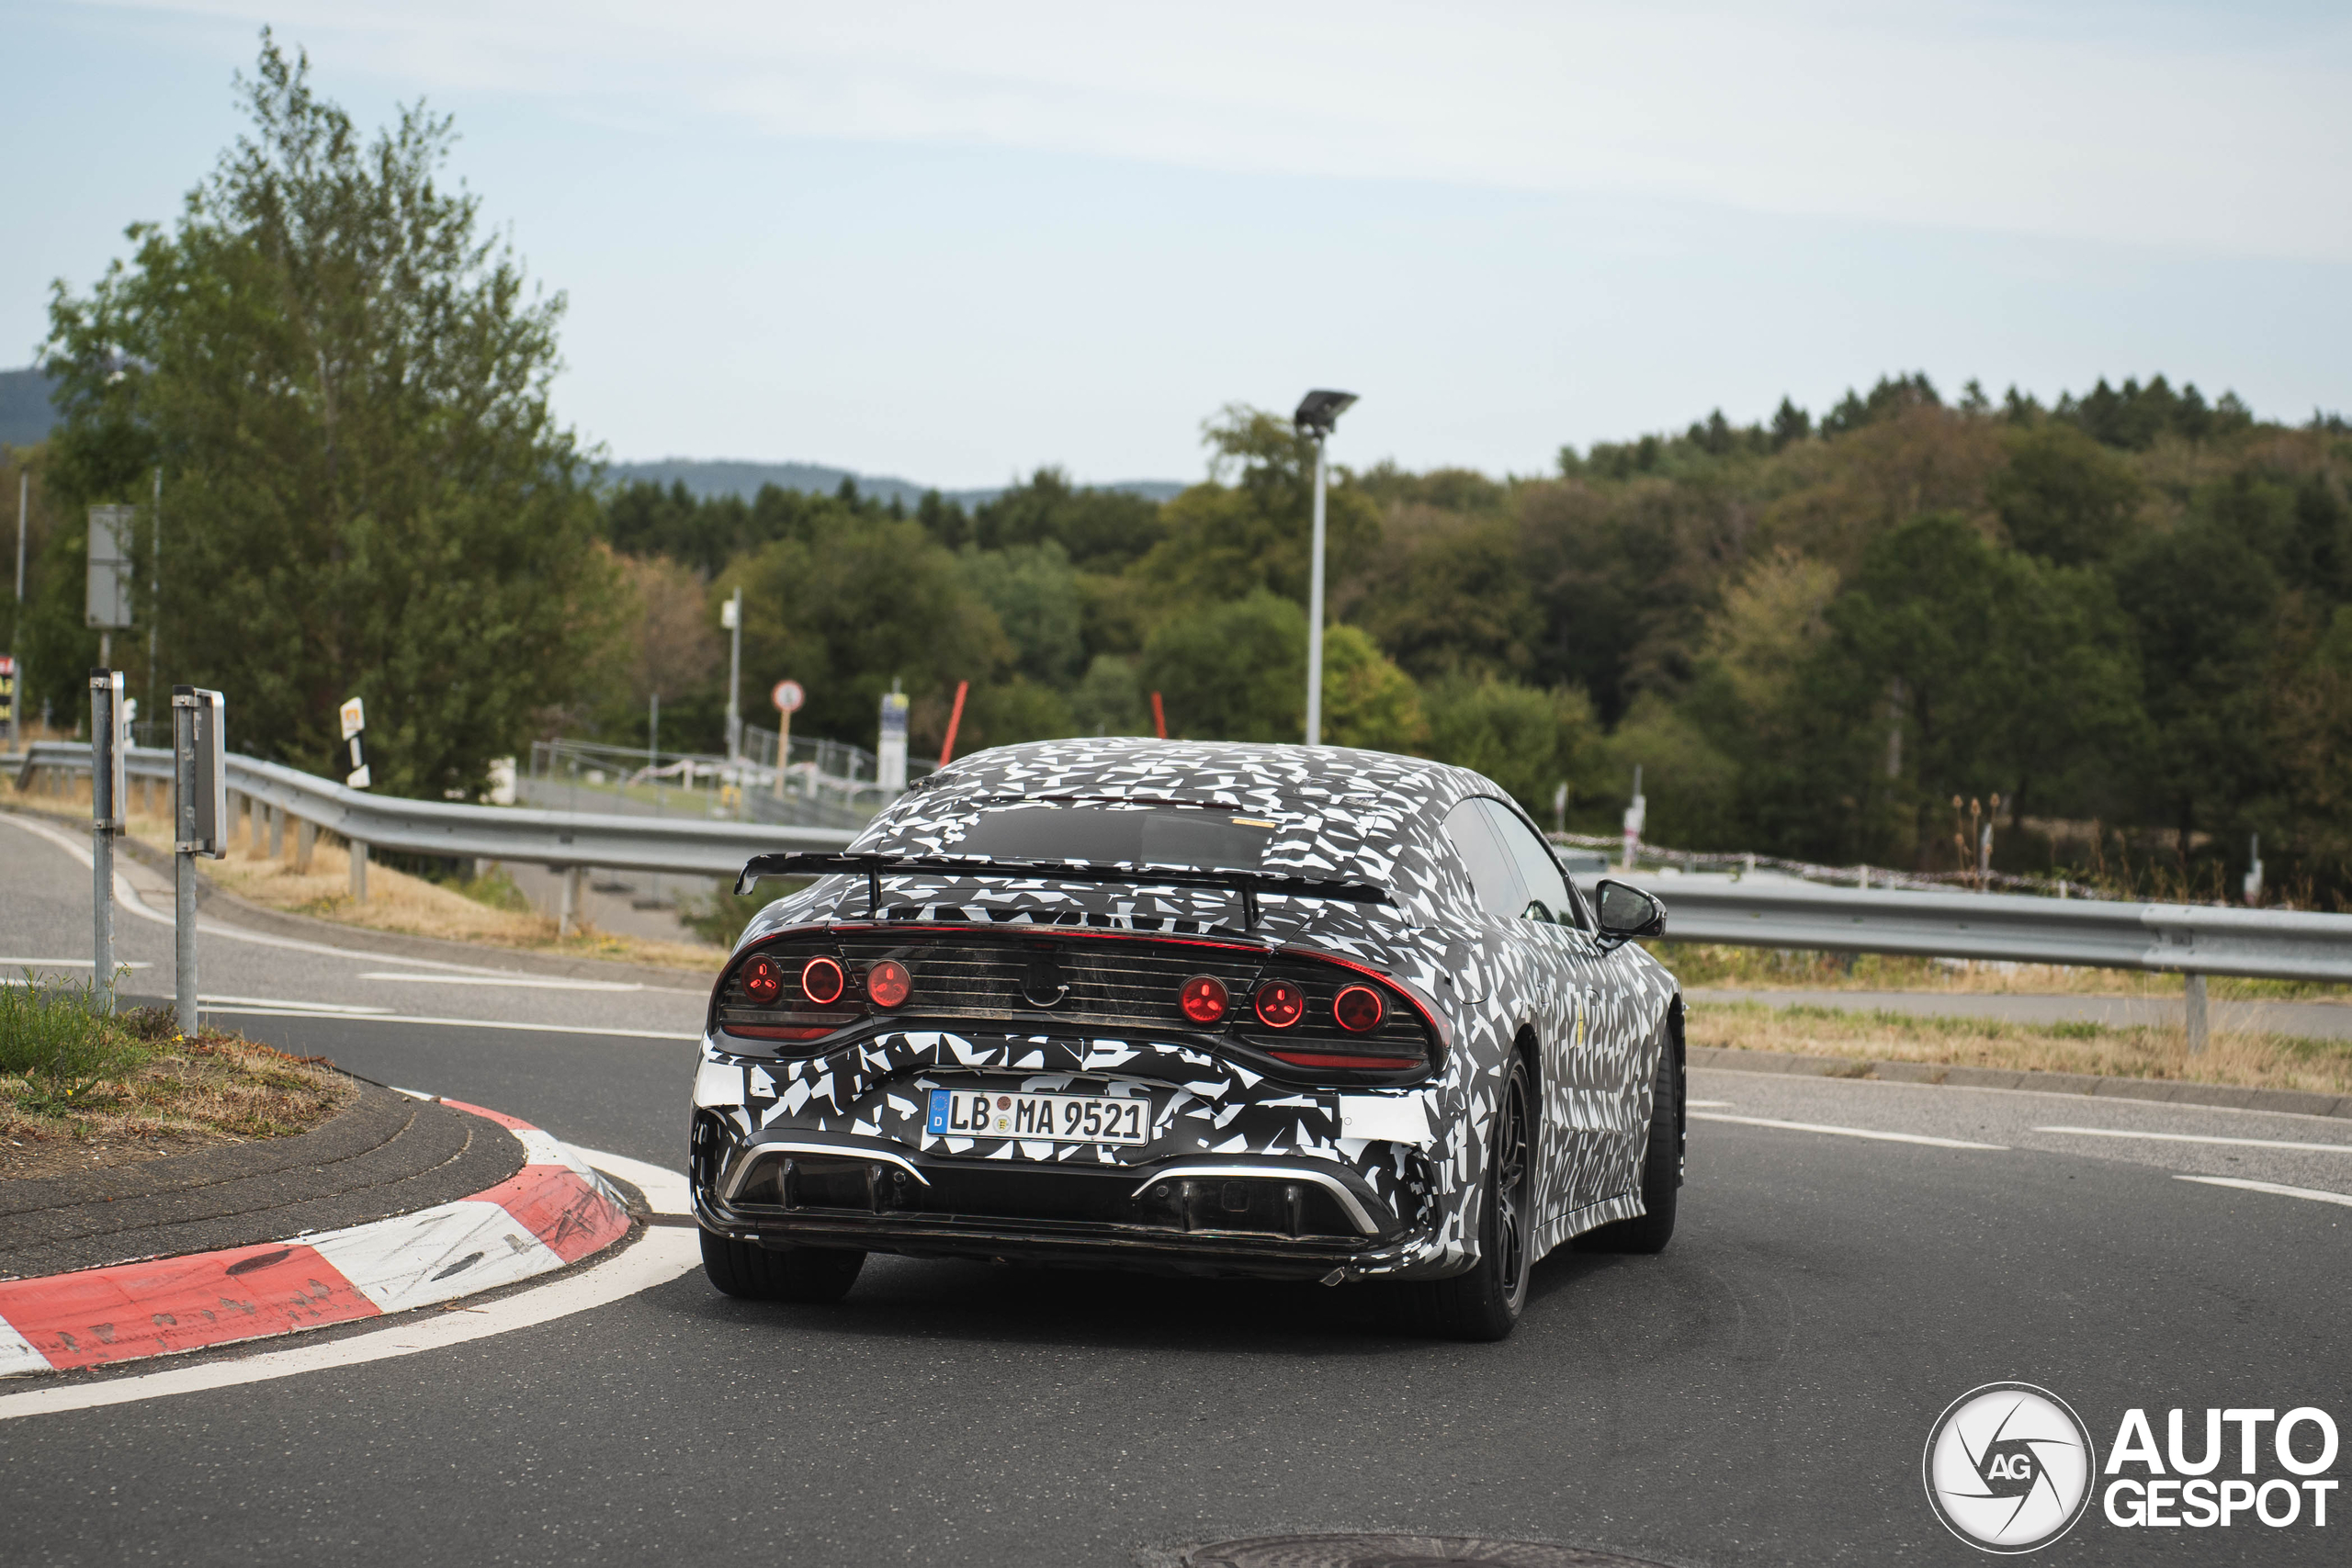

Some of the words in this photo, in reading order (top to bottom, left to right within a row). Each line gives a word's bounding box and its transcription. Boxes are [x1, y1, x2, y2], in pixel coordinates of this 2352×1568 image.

[933, 1116, 943, 1127] D
[950, 1095, 990, 1131] LB
[1014, 1099, 1054, 1134] MA
[1065, 1101, 1141, 1139] 9521
